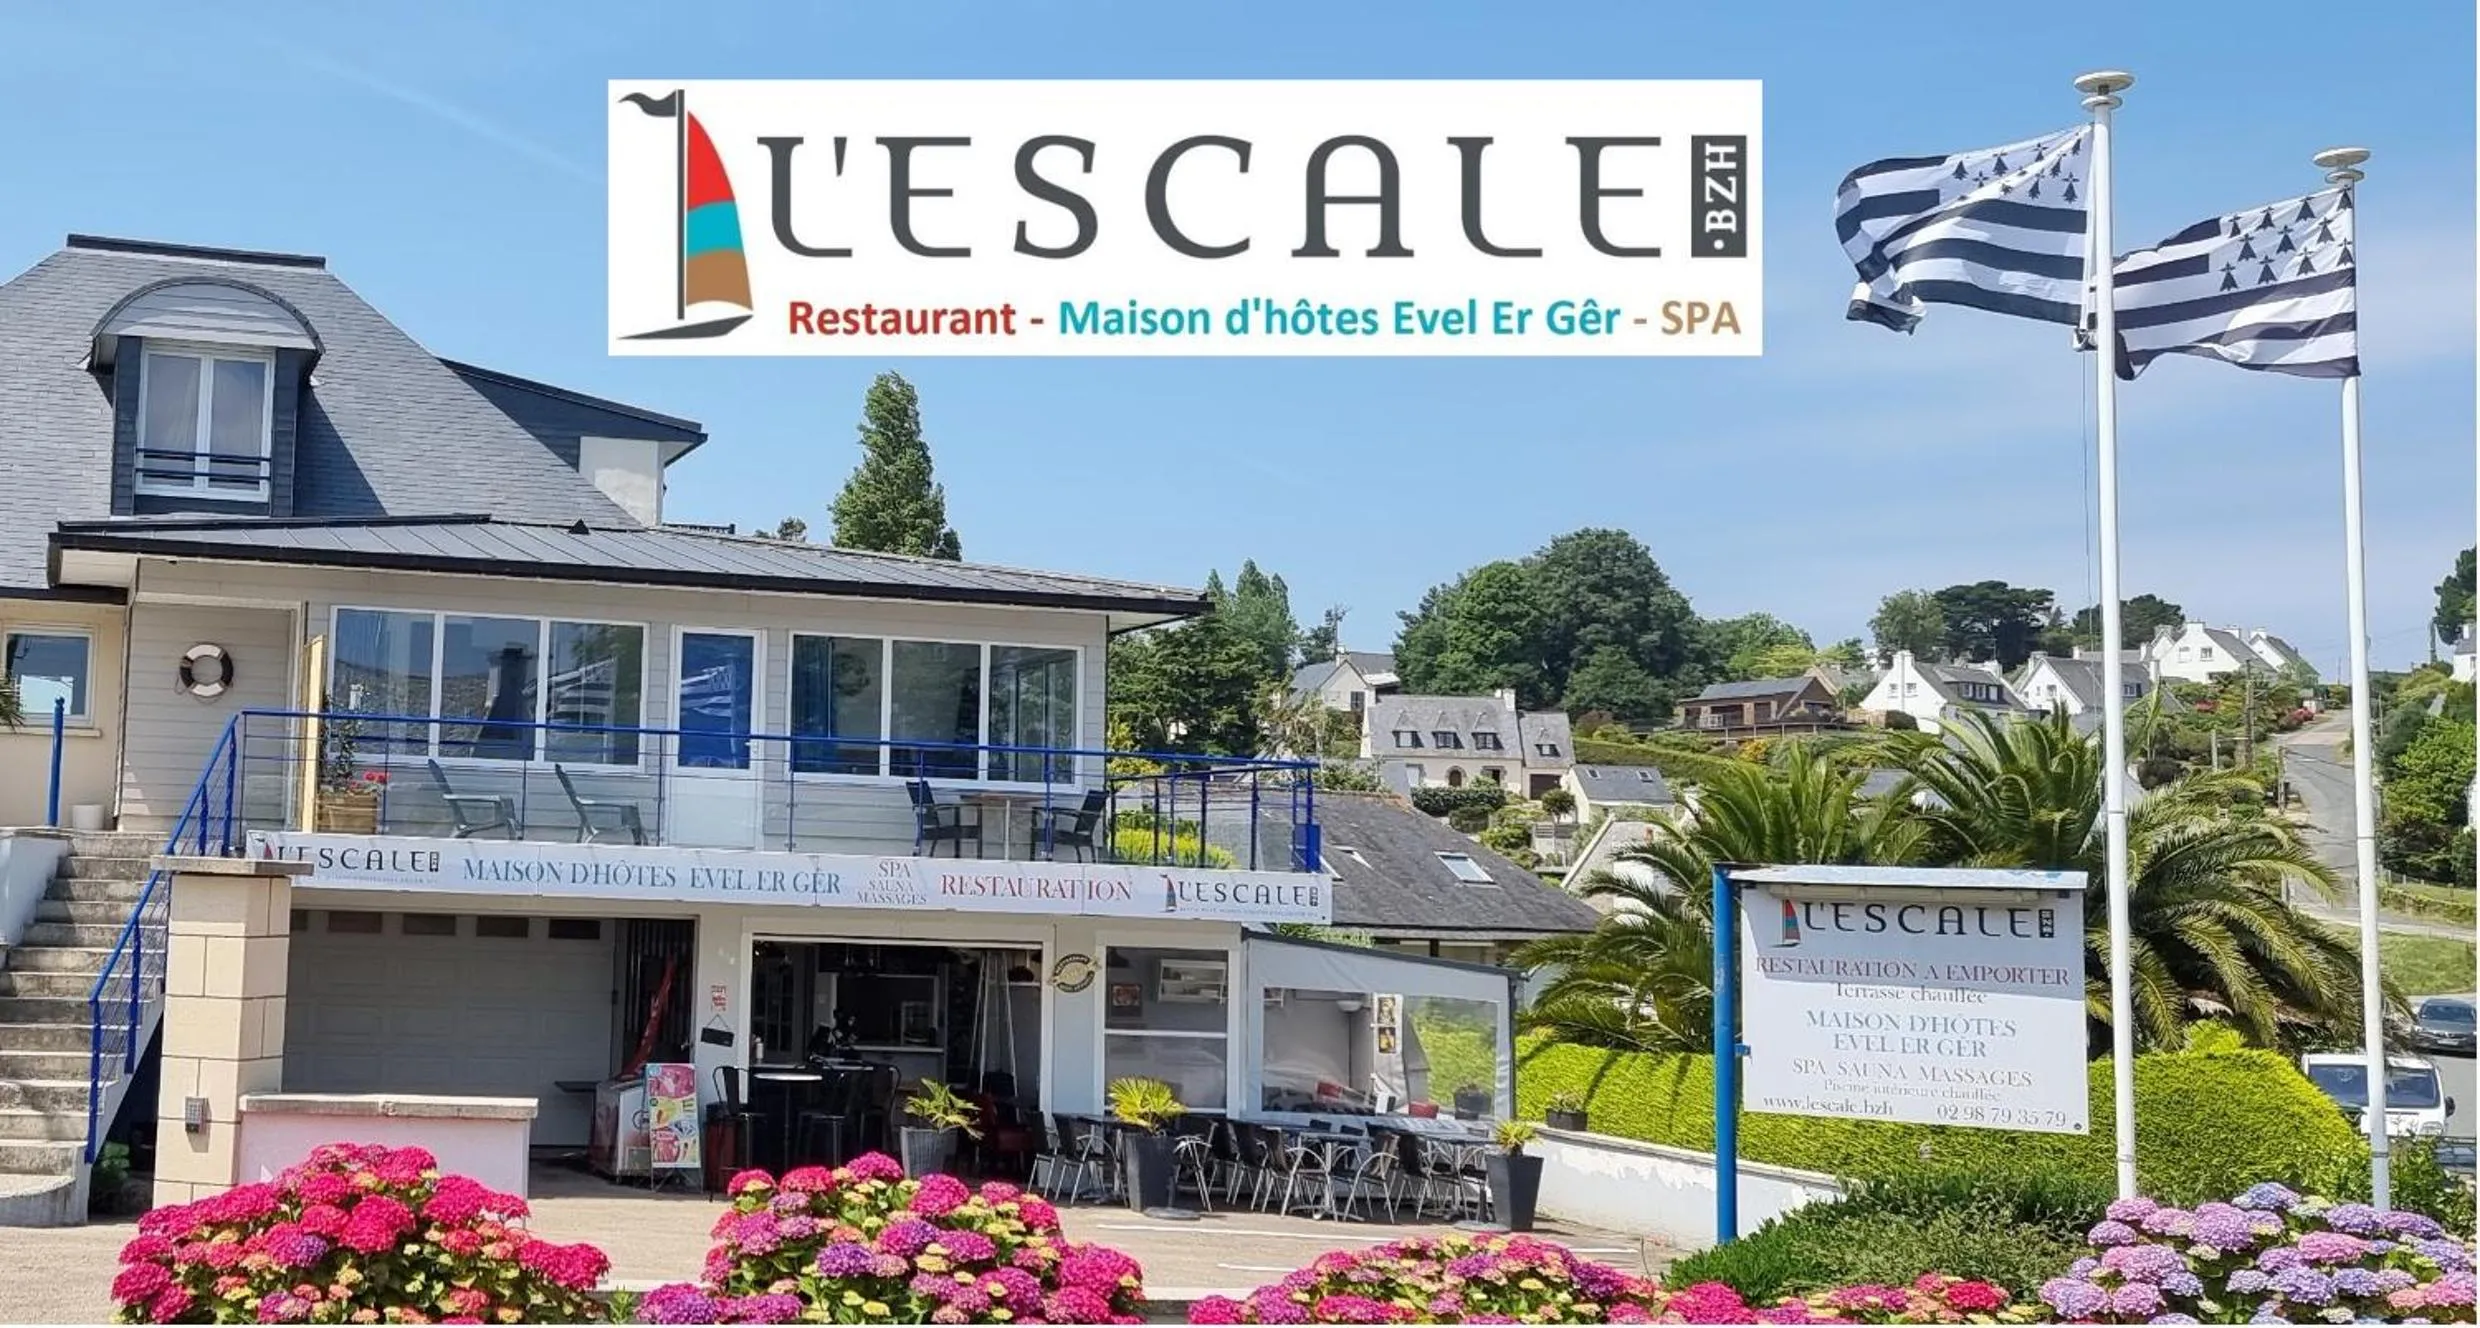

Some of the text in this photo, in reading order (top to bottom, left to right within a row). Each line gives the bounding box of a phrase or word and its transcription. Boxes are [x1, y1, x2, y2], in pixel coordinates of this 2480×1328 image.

[463, 858, 563, 883] MAISON
[571, 859, 677, 888] D'HÔTES
[690, 867, 752, 891] EVEL
[756, 870, 786, 892] ER
[879, 860, 911, 878] SPA
[857, 890, 928, 905] MASSAGES
[868, 878, 914, 893] SAUNA
[941, 873, 1133, 901] RESTAURATION
[1178, 880, 1307, 907] L'ESCALE
[1801, 901, 2033, 938] L'ESCALE
[1756, 955, 1918, 979] RESTAURATION
[1946, 964, 2070, 986] EMPORTER
[1835, 981, 1989, 1004] Terrasse chauffée
[1806, 1009, 2017, 1038] MAISON D'HÔTES
[1834, 1033, 1895, 1053] EVEL
[1901, 1036, 1930, 1055] ER
[1792, 1057, 2033, 1087] SPA SAUNA MASSAGES
[1763, 1096, 1893, 1115] www.lescale.bzh
[1936, 1104, 1958, 1121] 02
[1962, 1106, 1985, 1122] 98
[1991, 1108, 2012, 1124] 79
[2044, 1111, 2066, 1128] 79
